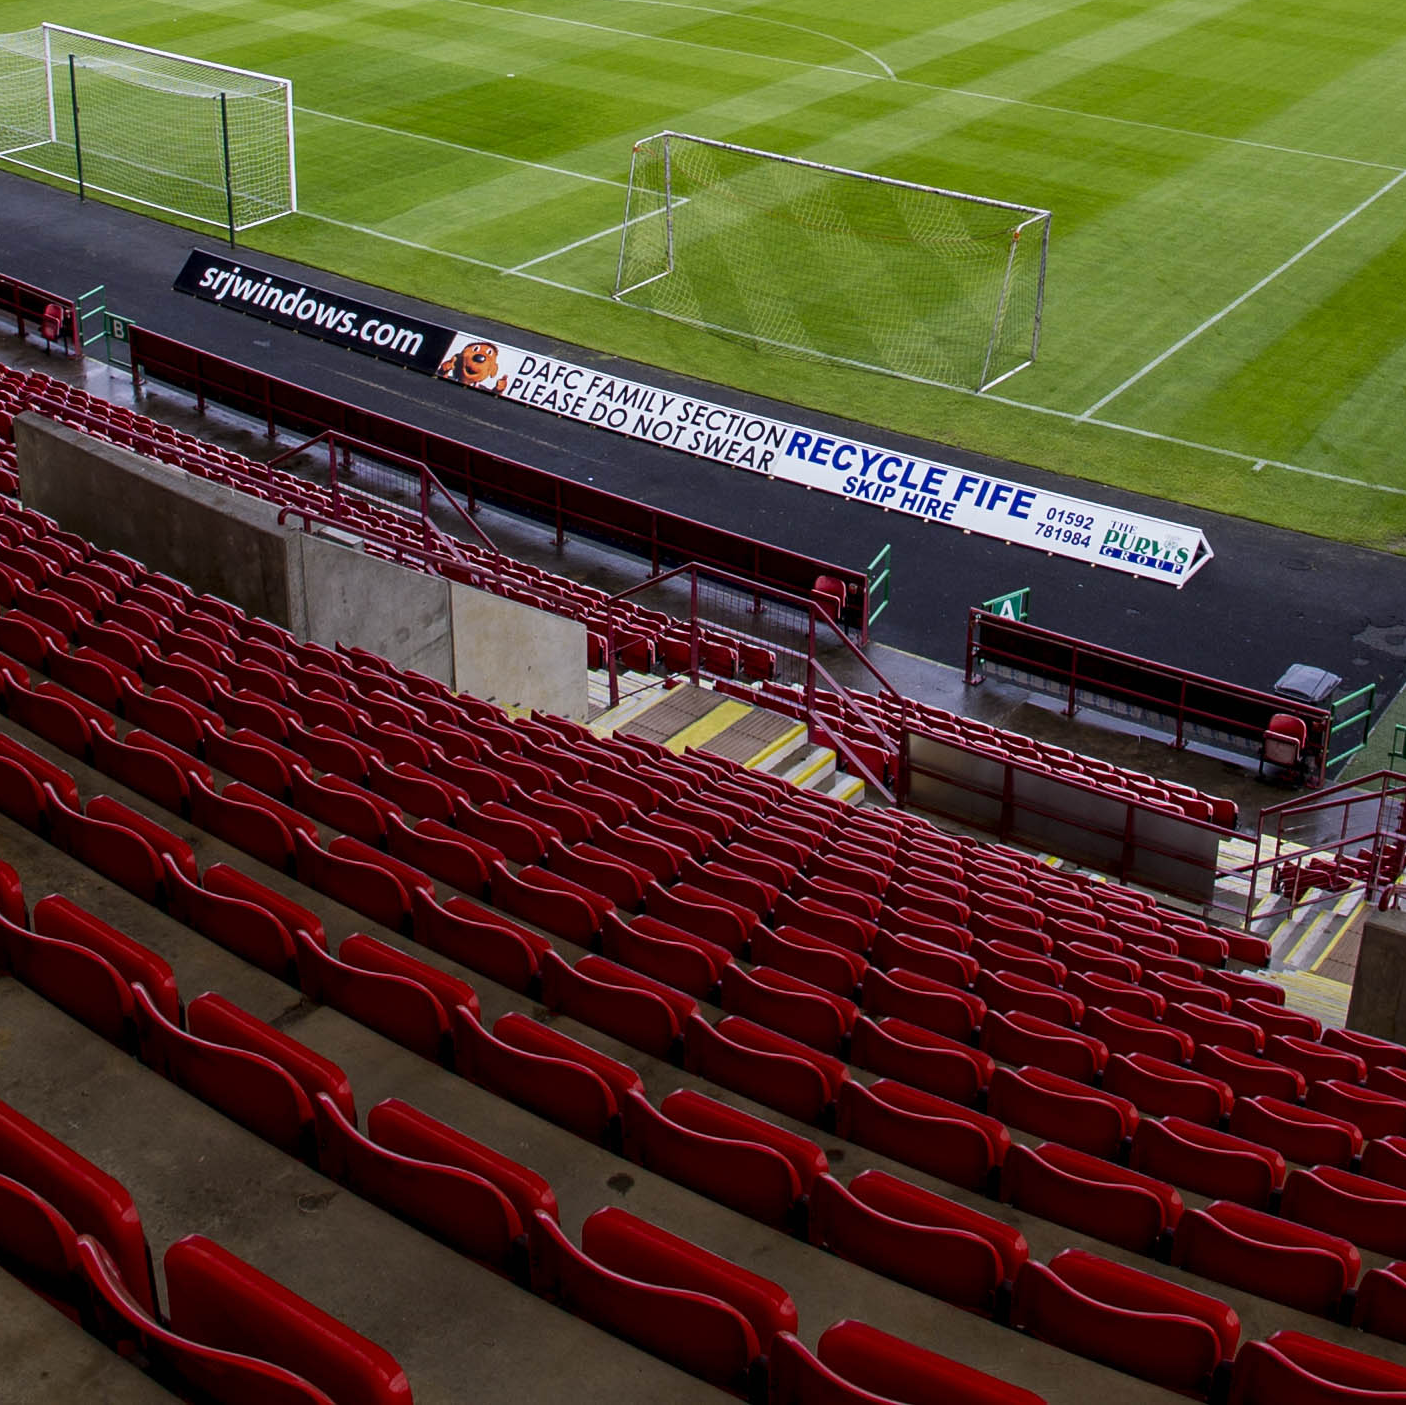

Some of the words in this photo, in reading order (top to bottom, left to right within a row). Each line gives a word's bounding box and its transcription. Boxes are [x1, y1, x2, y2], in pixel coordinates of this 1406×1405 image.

[199, 265, 425, 357] srjwindows.com
[113, 319, 125, 340] B
[518, 355, 584, 390] DAFC
[586, 375, 676, 416] FAMILY
[677, 401, 788, 449] SECTION
[506, 377, 587, 418] PLEASE
[589, 401, 628, 429] DO
[632, 414, 688, 445] NOT
[687, 430, 775, 473] SWEAR
[784, 430, 949, 497] RECYCLE
[952, 475, 1038, 520] FIFE
[841, 474, 896, 506] SKIP
[900, 491, 958, 522] HIRE
[1034, 521, 1093, 549] 781984
[1045, 506, 1095, 531] 01592
[1110, 520, 1138, 534] THE
[1101, 544, 1183, 574] GROUP
[1102, 528, 1190, 565] PURVIS
[999, 599, 1016, 622] A
